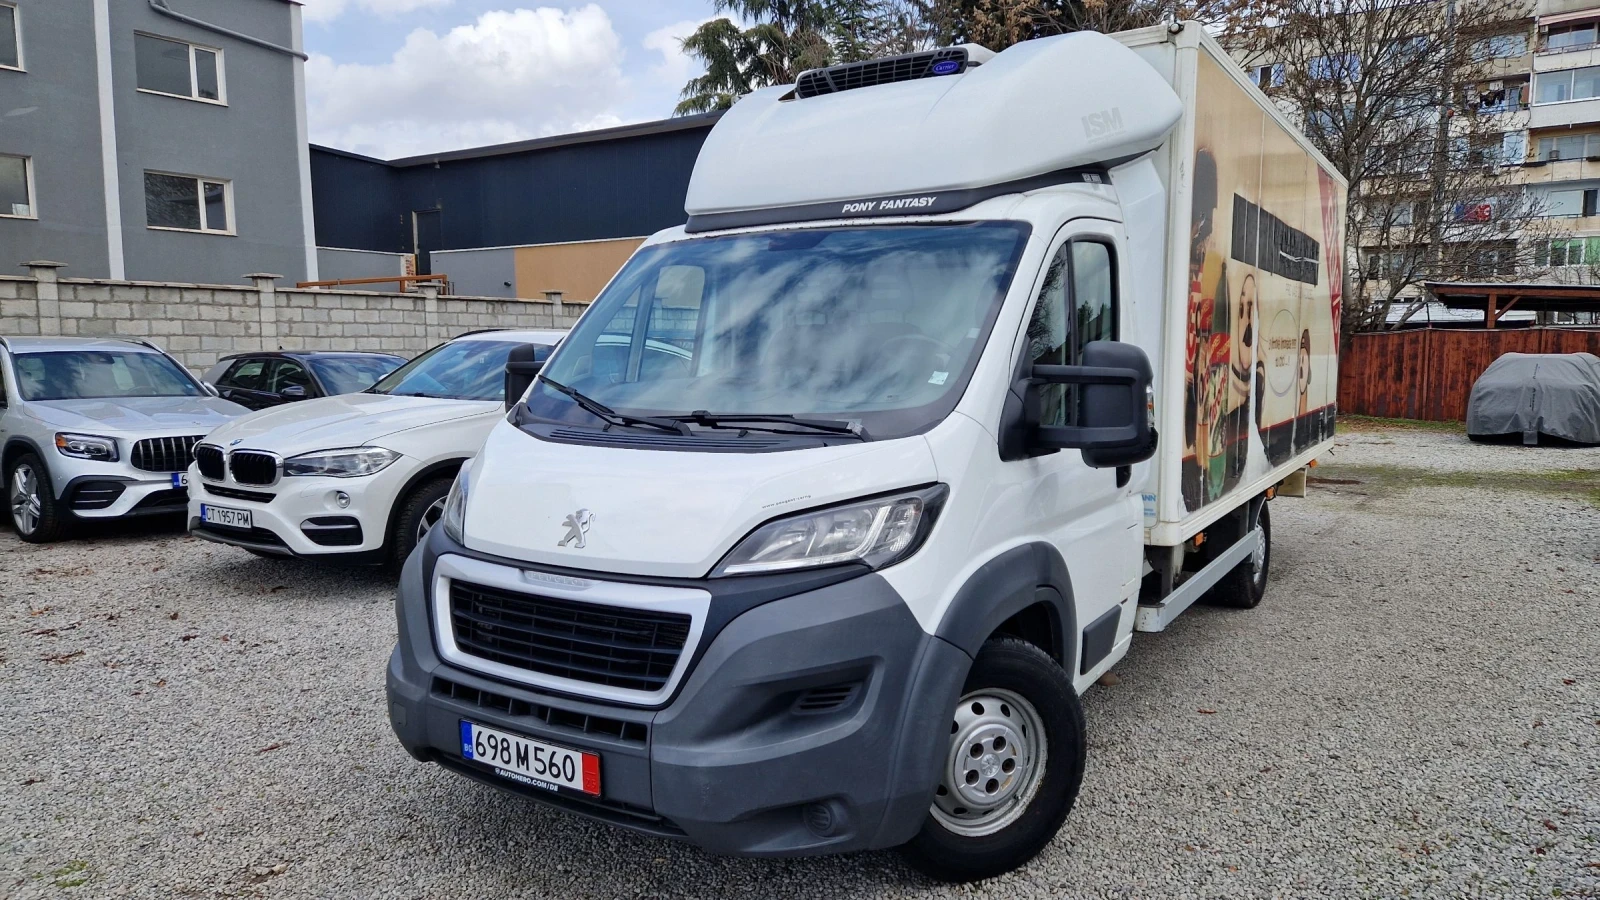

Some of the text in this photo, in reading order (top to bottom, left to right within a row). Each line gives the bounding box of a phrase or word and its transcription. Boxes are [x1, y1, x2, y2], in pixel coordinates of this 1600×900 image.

[1081, 107, 1124, 138] ISM
[841, 196, 937, 213] PONY FANTASY
[206, 507, 215, 521] CT
[217, 510, 236, 524] 1957
[237, 512, 249, 526] PM
